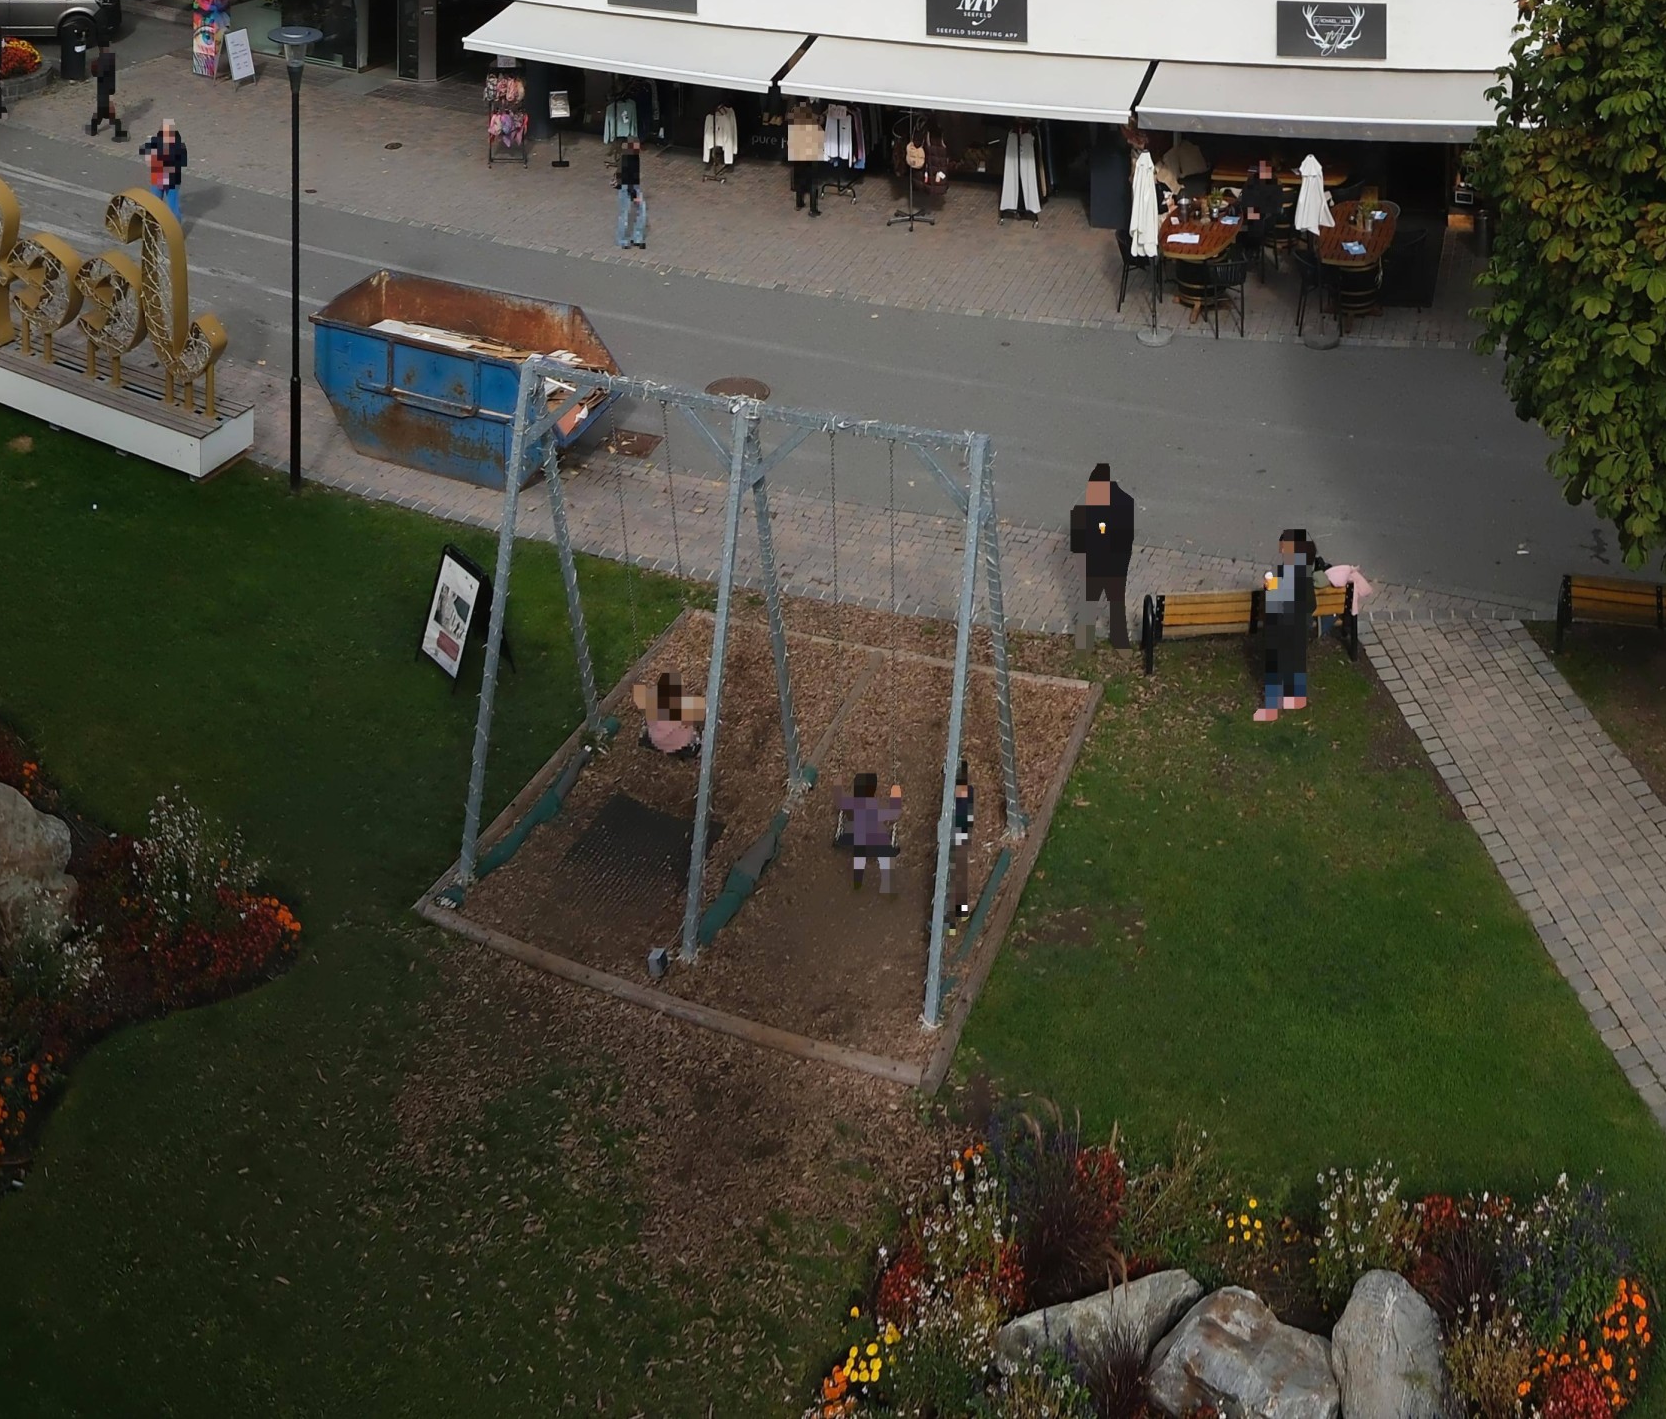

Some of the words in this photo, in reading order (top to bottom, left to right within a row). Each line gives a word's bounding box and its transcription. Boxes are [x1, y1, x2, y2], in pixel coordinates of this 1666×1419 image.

[963, 11, 992, 19] SEEFELD
[936, 27, 965, 35] SEEFELD
[967, 30, 1002, 38] SHOPPING
